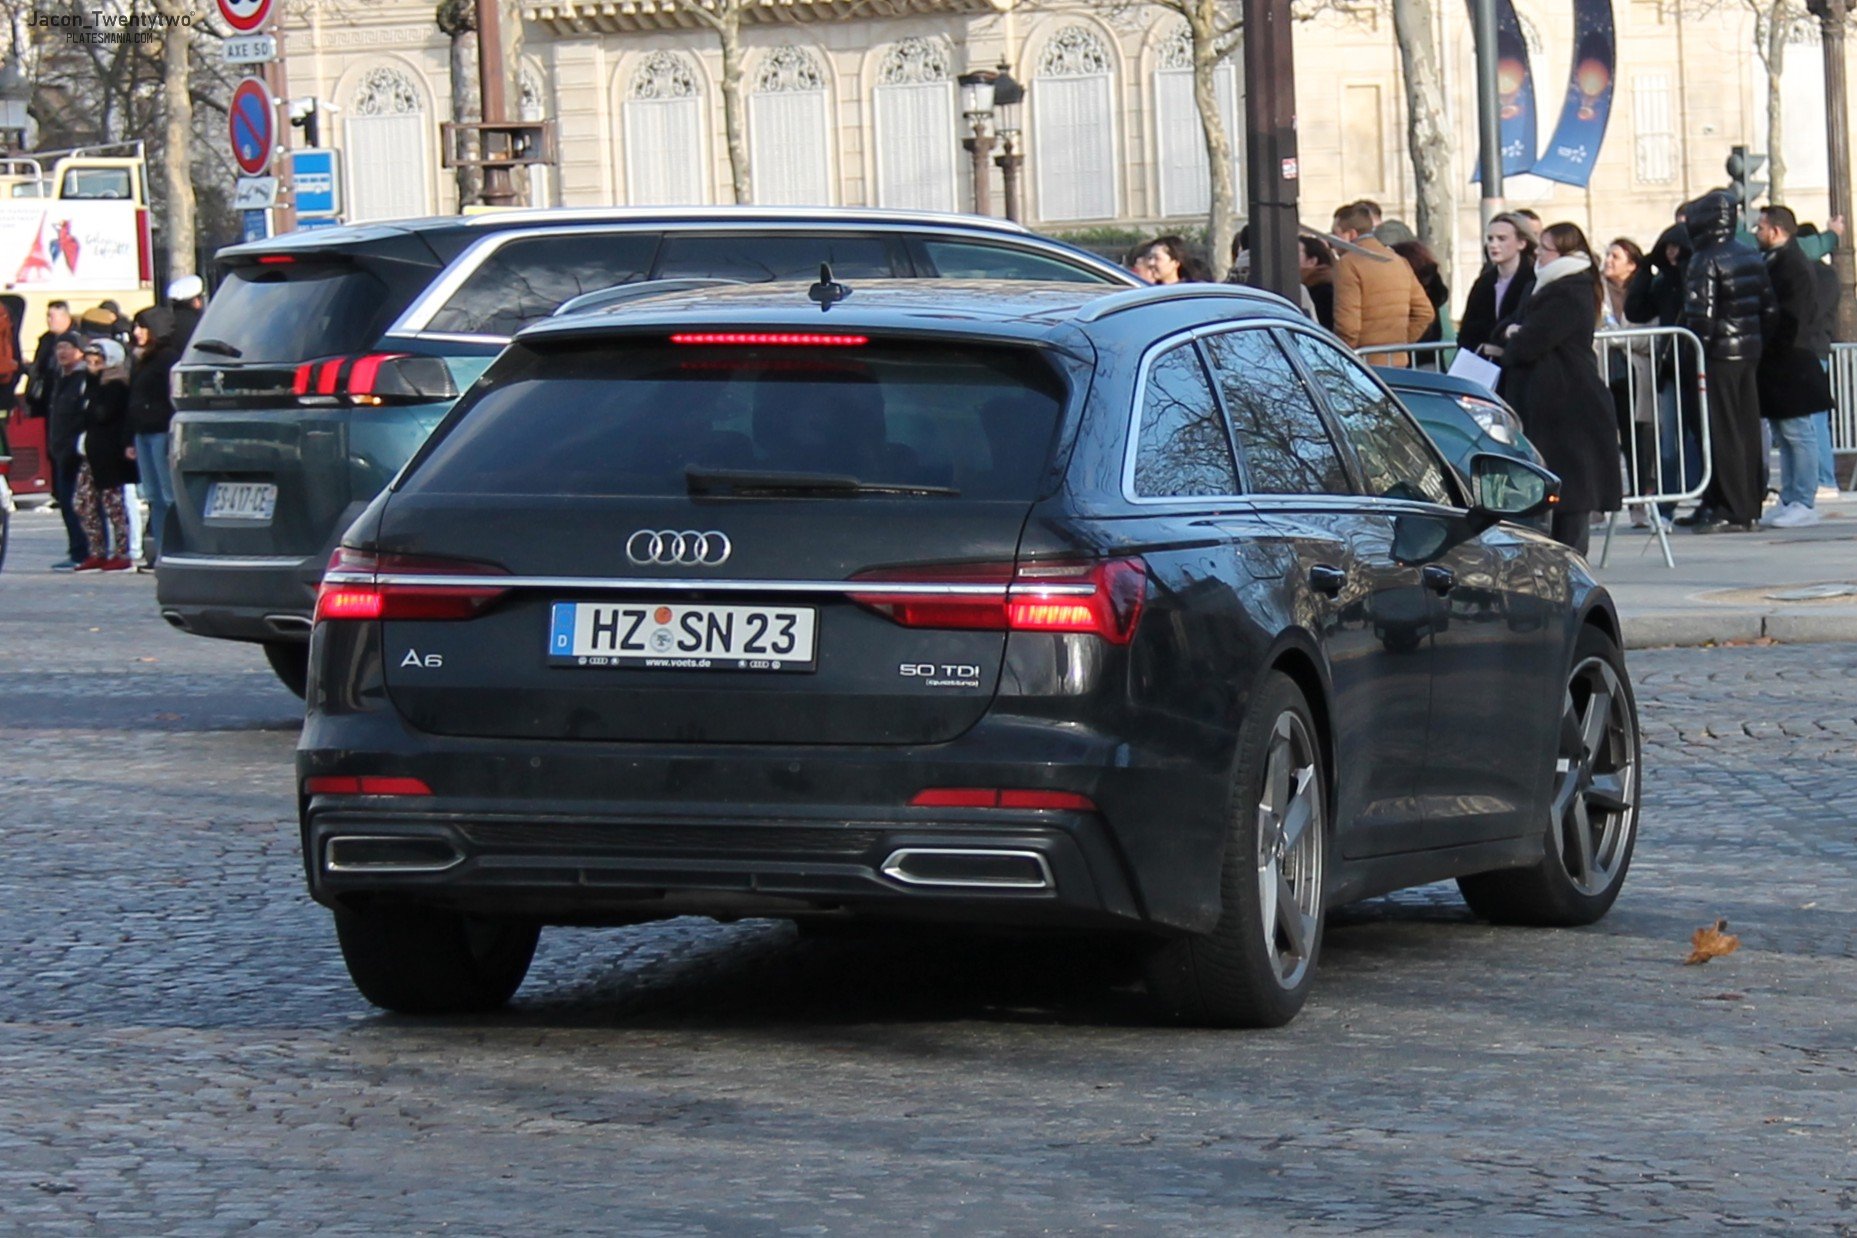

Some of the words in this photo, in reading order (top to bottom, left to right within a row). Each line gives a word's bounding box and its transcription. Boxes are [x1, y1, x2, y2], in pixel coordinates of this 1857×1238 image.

[228, 44, 249, 57] AXE
[254, 43, 269, 56] 50
[557, 635, 568, 648] D
[591, 609, 647, 650] HZ
[677, 611, 734, 653] SN
[743, 612, 799, 655] 23
[400, 648, 443, 668] A6
[645, 658, 711, 668] www.voets.de
[899, 663, 935, 677] 50
[941, 665, 980, 678] TDI
